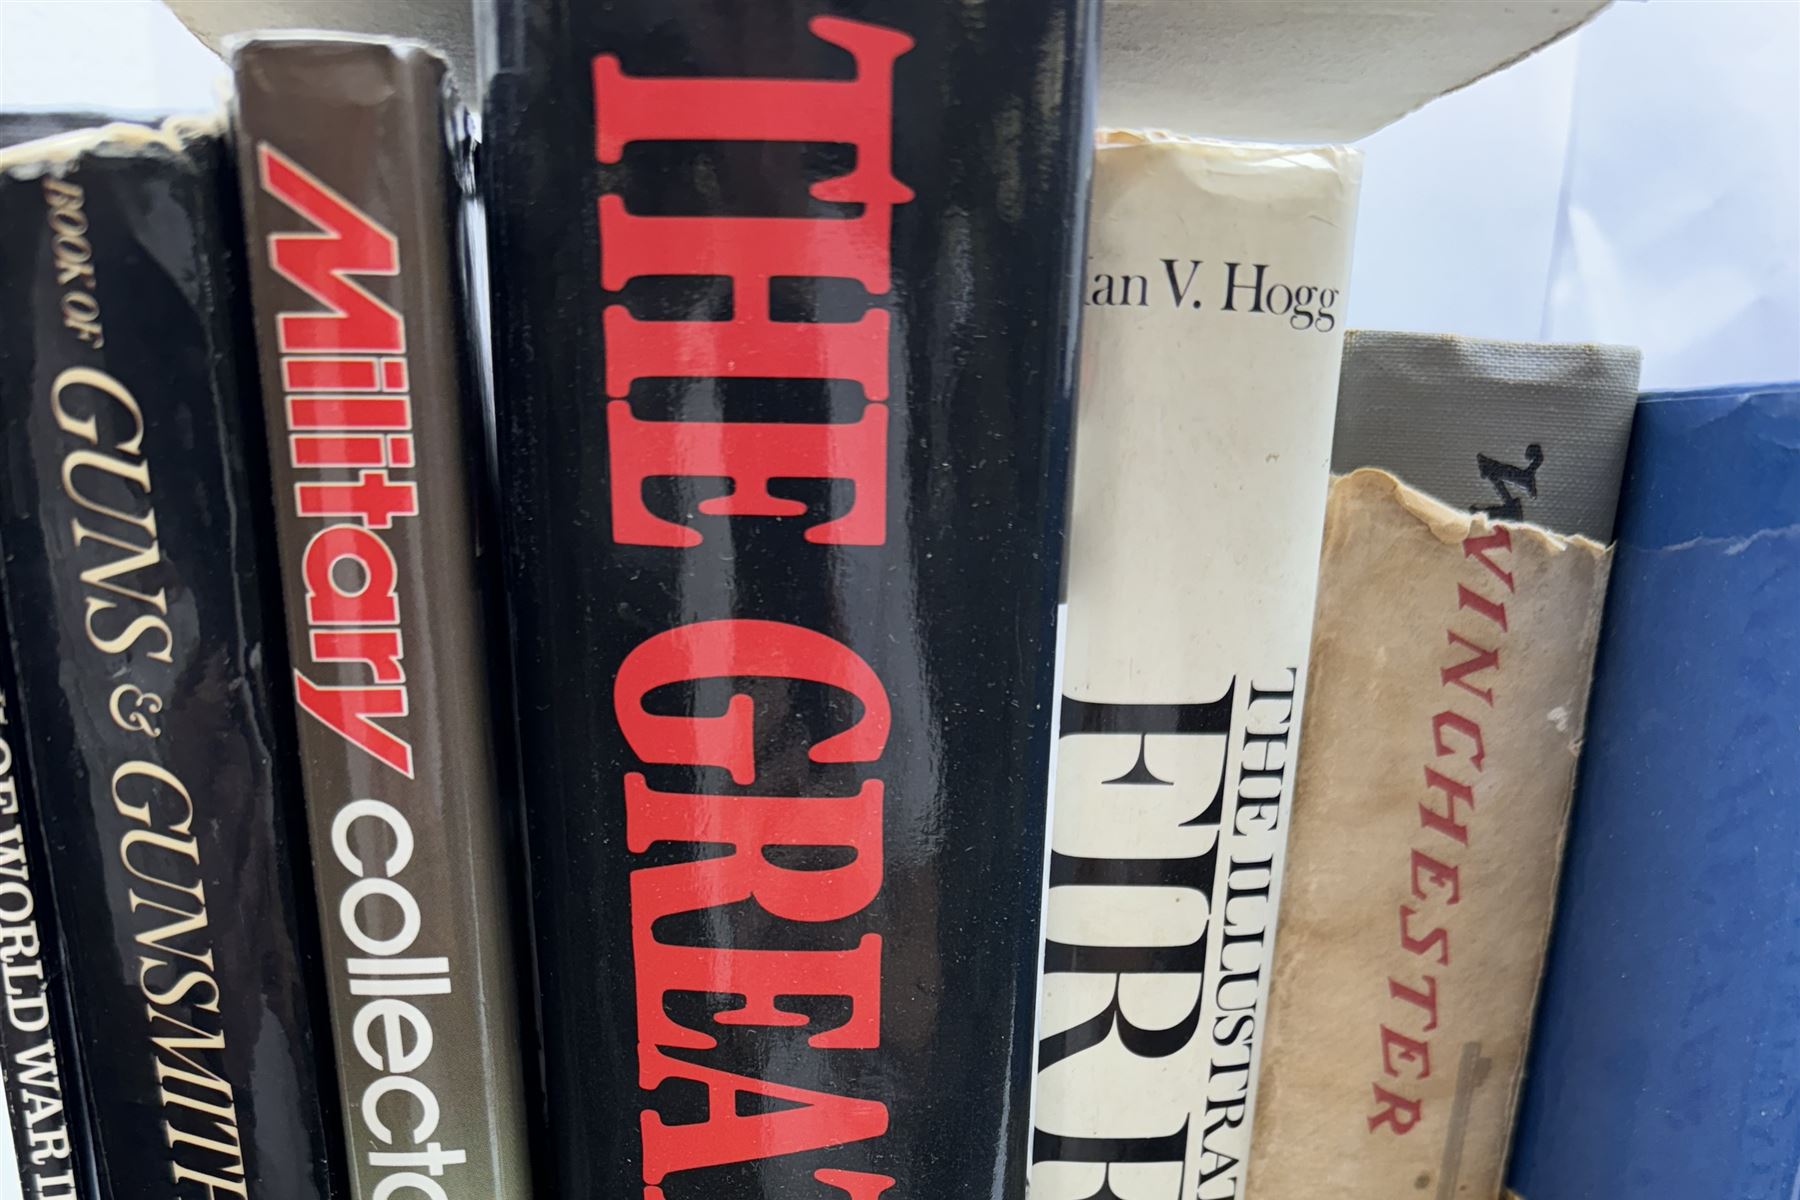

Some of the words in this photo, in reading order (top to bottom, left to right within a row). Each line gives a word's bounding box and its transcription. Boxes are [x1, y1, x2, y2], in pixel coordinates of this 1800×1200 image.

[43, 177, 97, 288] BOOK
[592, 15, 916, 546] THE
[1084, 273, 1149, 307] an
[1160, 259, 1203, 309] V.
[1220, 262, 1340, 333] Hogg
[62, 290, 105, 349] OF
[50, 366, 174, 664] GUNS
[258, 141, 418, 779] Military
[109, 684, 164, 738] &
[1232, 667, 1299, 837] THE
[0, 822, 50, 1033] WORLD
[15, 1039, 72, 1165] WAR
